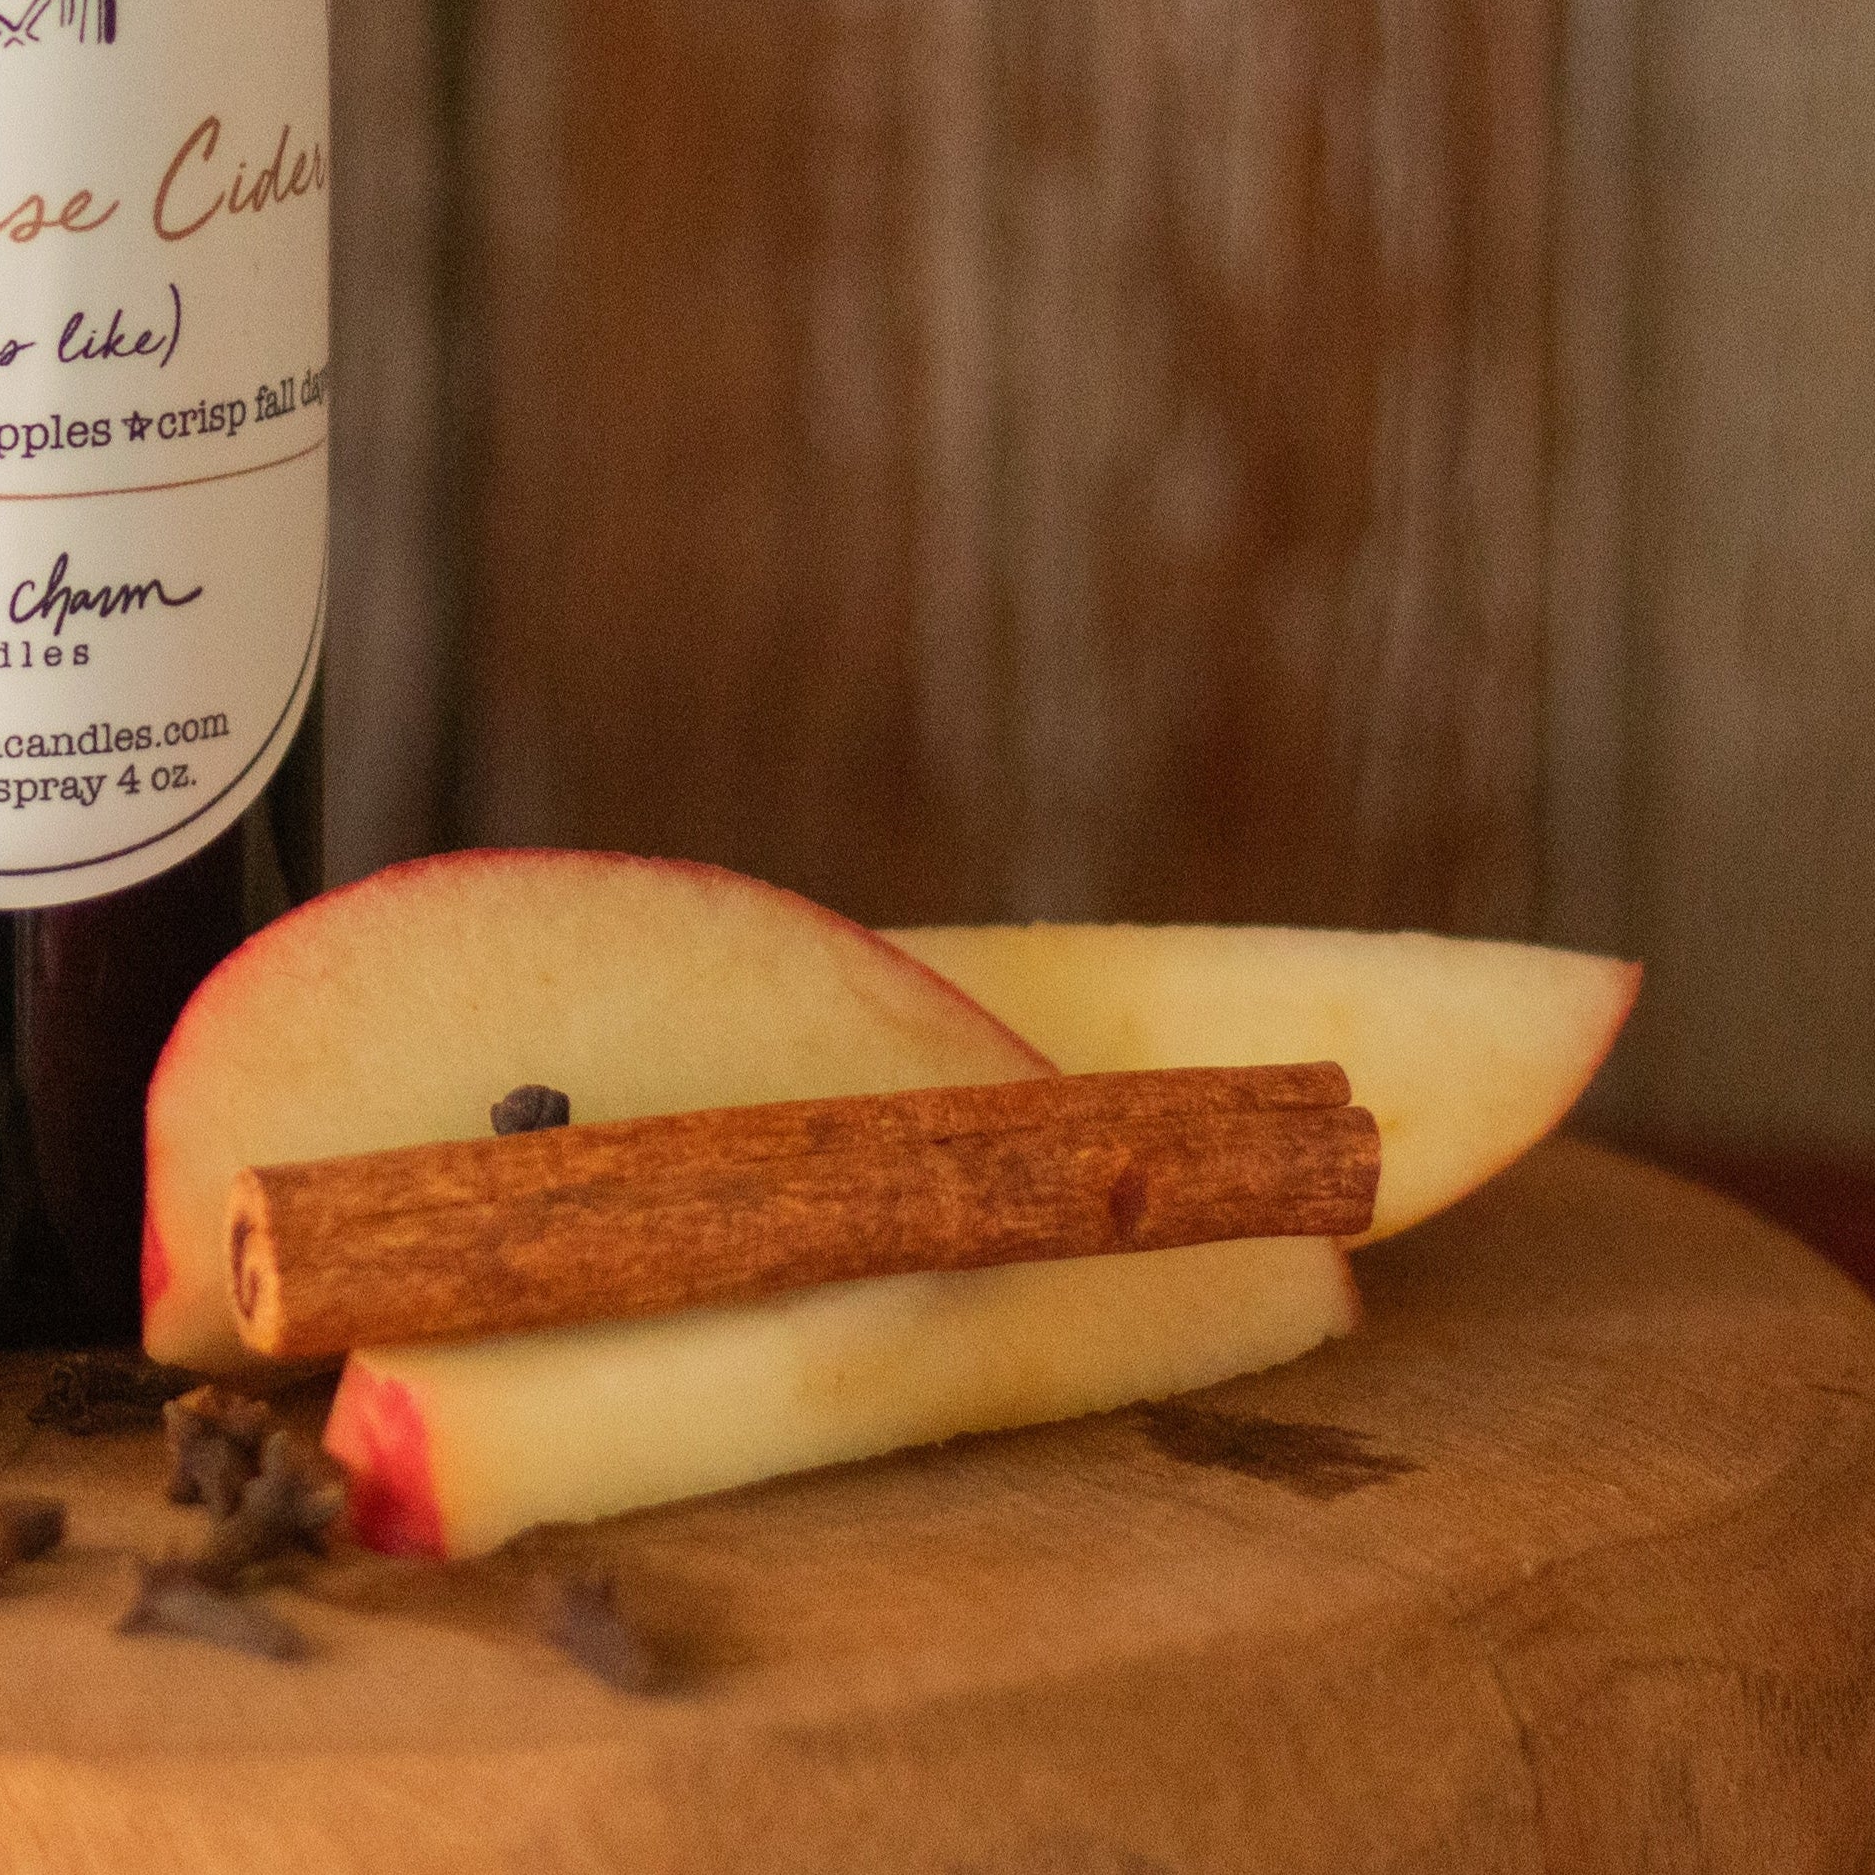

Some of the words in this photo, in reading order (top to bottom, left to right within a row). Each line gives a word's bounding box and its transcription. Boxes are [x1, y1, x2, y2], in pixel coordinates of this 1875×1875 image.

[153, 114, 325, 243] Cider
[57, 282, 182, 368] like)
[156, 398, 248, 438] crisp
[254, 383, 296, 423] fall
[116, 763, 141, 795] 4
[150, 763, 198, 791] oz.
